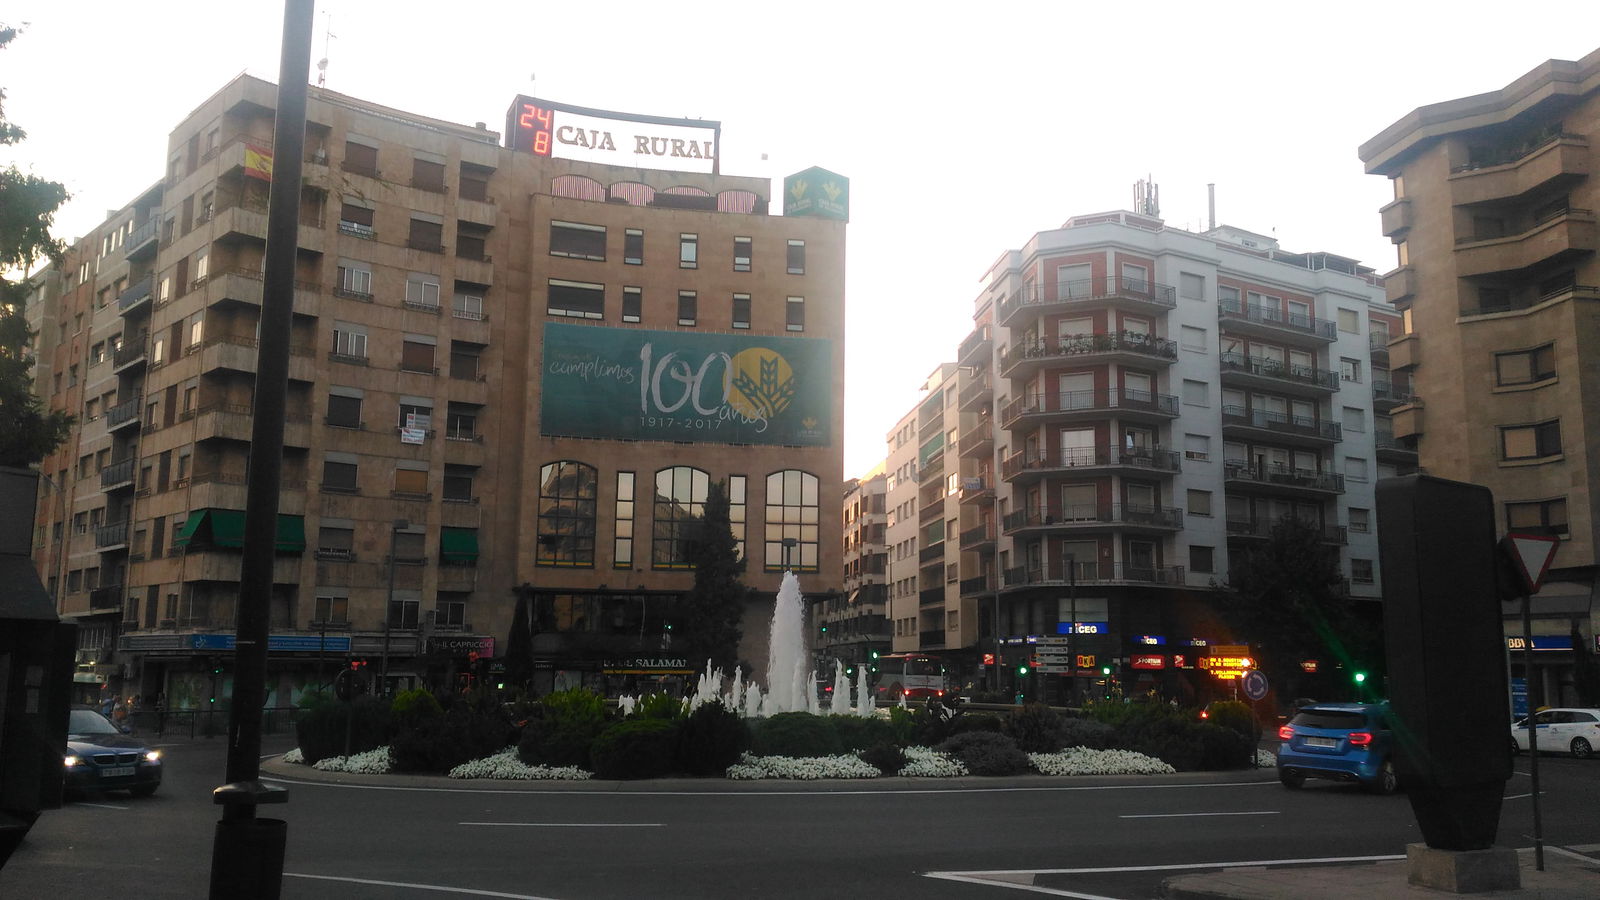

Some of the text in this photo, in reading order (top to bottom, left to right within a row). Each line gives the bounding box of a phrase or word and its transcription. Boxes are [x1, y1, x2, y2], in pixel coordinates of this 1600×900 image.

[520, 104, 552, 129] 24
[534, 131, 549, 155] 8
[556, 125, 715, 160] CAJA RURAL
[549, 342, 733, 416] cumplimos 100
[640, 416, 723, 430] 1917-2017
[718, 400, 768, 433] años
[450, 641, 493, 649] CAPRICCIO
